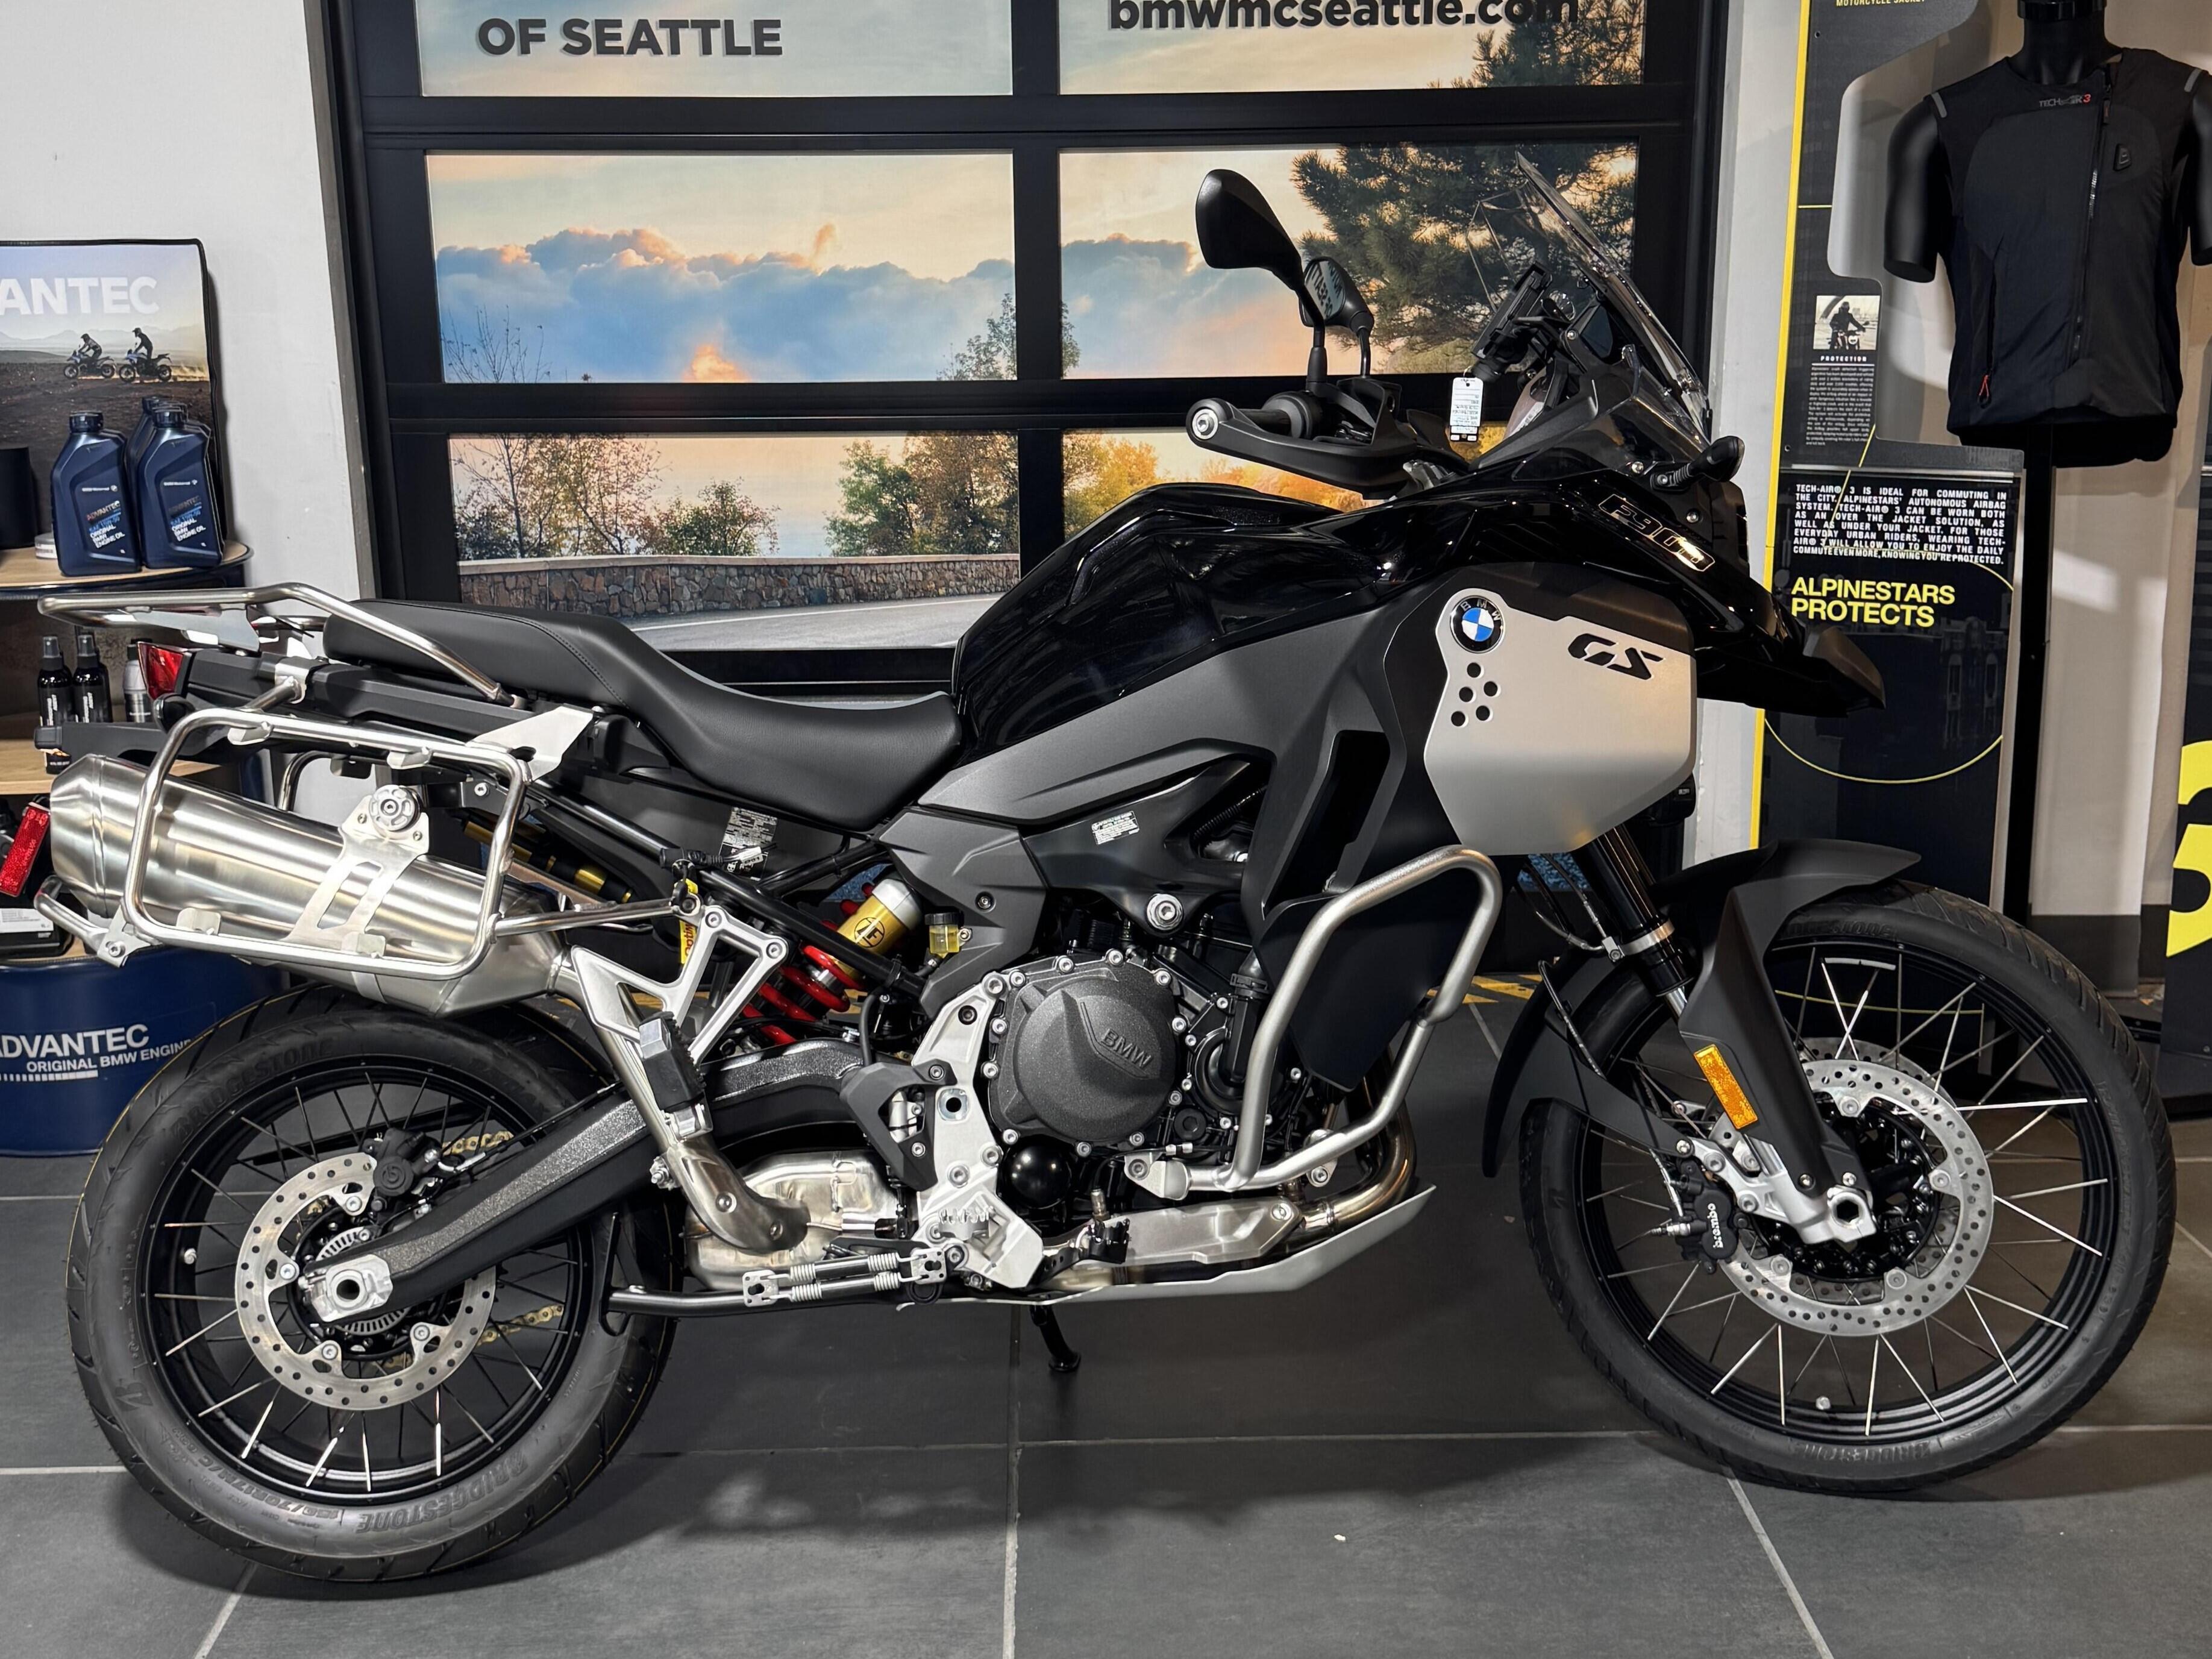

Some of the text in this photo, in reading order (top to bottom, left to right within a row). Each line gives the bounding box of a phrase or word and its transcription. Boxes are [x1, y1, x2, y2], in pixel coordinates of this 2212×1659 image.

[1110, 0, 1579, 29] bmwmcseattle.com
[477, 18, 783, 57] OF SEATTLE
[2083, 93, 2091, 103] 3
[1879, 488, 1903, 496] IDEAL
[1937, 490, 1988, 499] COMMUTING
[1909, 498, 1967, 507] AUTONOMOUS
[1973, 501, 2006, 509] AIRBAG
[1841, 522, 1870, 530] UNDER
[1975, 528, 2004, 536] THOSE
[1892, 515, 1927, 524] JACKET
[1794, 528, 1838, 537] EVERYDAY
[1928, 535, 1970, 544] WEARING
[1978, 537, 2005, 545] TECH-
[1853, 540, 1883, 548] ALLOW
[1924, 544, 1952, 552] ENJOY
[1791, 577, 1955, 604] ALPINESTARS
[1460, 599, 1502, 621] BMW
[1791, 598, 1935, 627] PROTECTS
[1567, 633, 1665, 680] GS
[0, 1024, 149, 1058] DVANTEC
[1101, 1028, 1153, 1068] BMW
[27, 1058, 98, 1073] ORIGINAL
[99, 1052, 137, 1067] BMW
[1707, 1203, 1723, 1249] brembo
[356, 1449, 529, 1534] BRIDGESTONE
